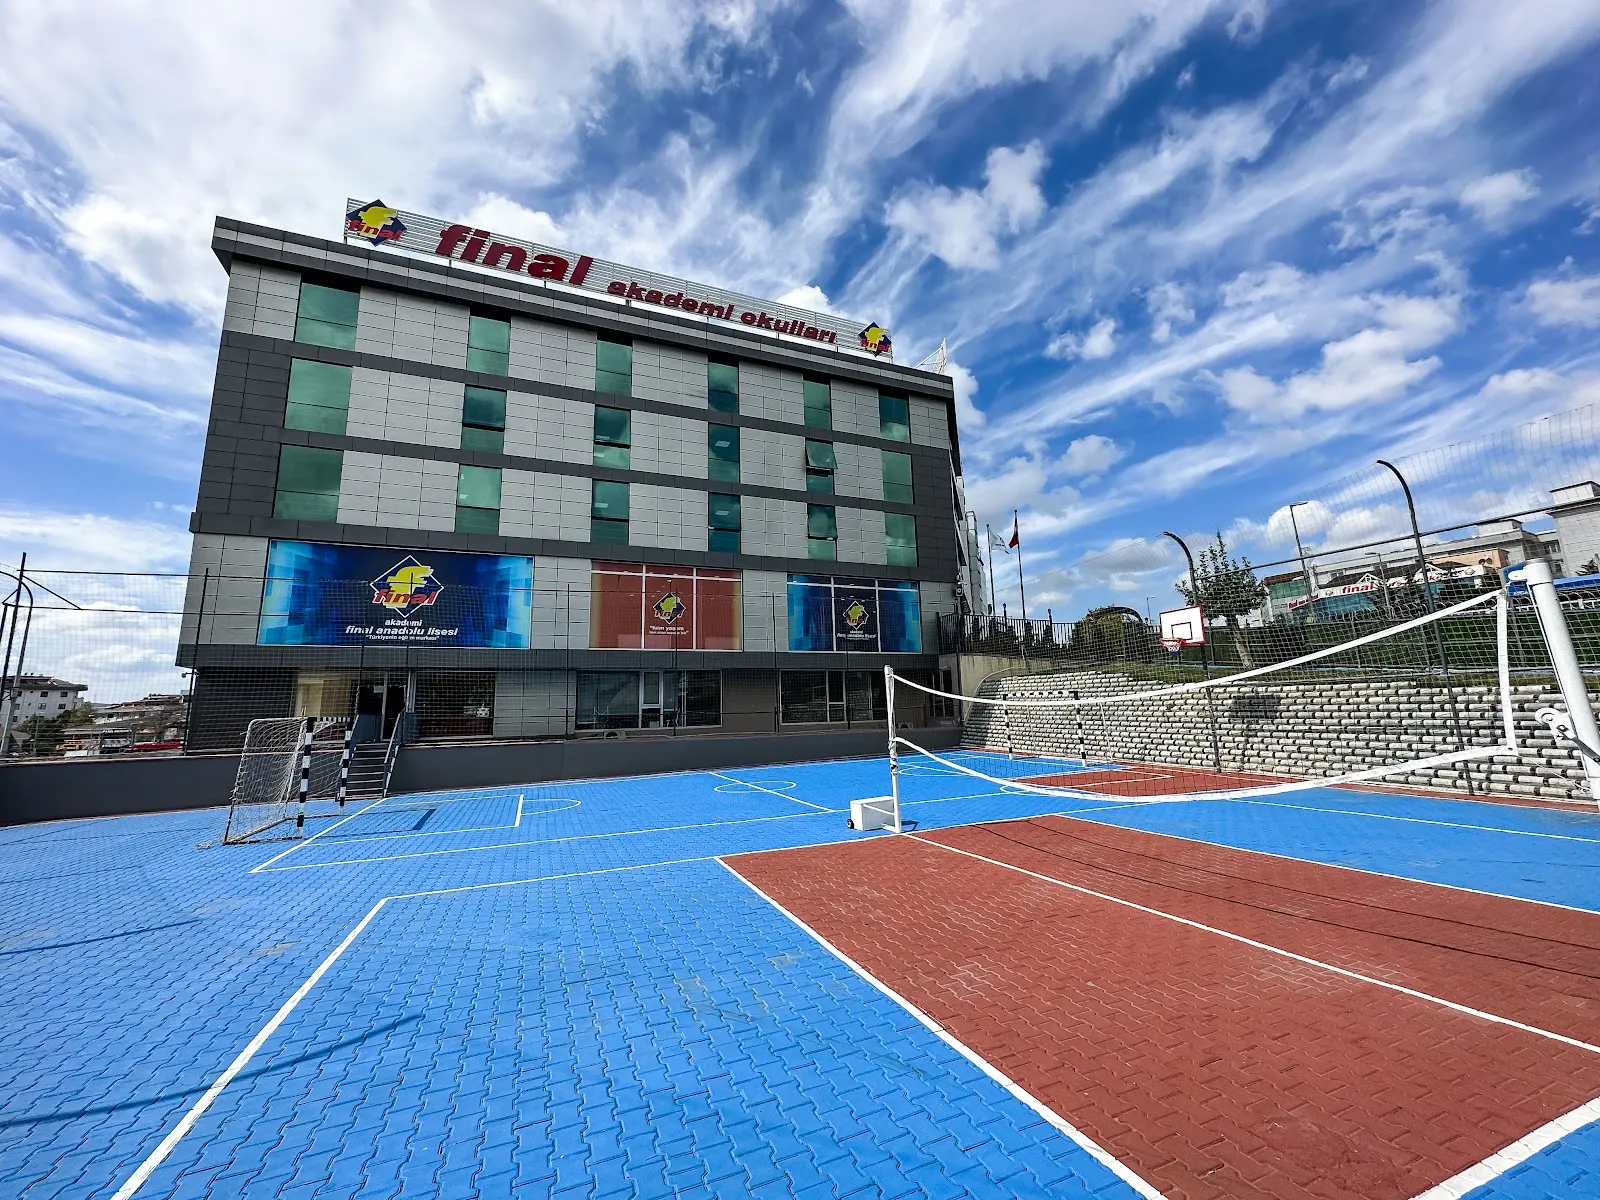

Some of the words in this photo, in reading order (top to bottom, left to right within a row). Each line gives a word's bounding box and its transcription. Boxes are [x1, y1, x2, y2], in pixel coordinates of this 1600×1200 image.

[347, 218, 403, 240] final
[435, 224, 594, 286] final
[607, 281, 735, 321] akademi
[740, 311, 837, 344] okulları
[373, 588, 438, 605] final
[1341, 581, 1375, 594] final
